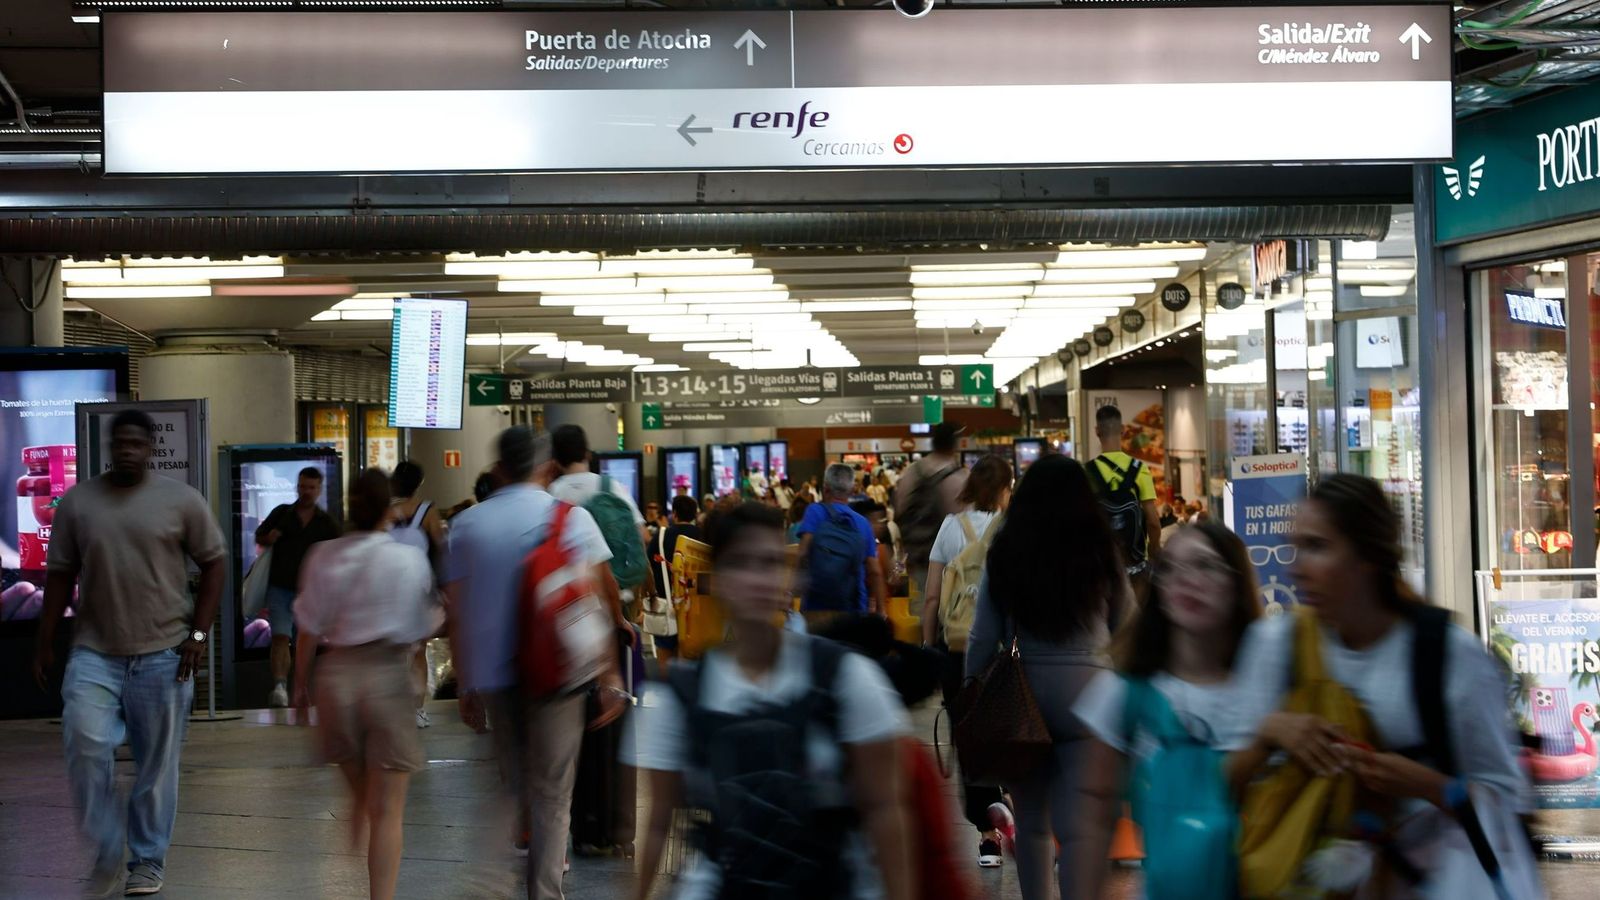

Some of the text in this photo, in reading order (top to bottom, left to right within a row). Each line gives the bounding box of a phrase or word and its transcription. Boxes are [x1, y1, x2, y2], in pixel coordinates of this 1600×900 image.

[525, 28, 711, 50] Puerta de Atocha
[1258, 22, 1372, 44] Salida/Exit
[1258, 45, 1380, 64] C/Méndez Álvaro
[525, 55, 670, 73] Salidas/Departures
[732, 101, 830, 139] renfe
[1165, 289, 1186, 301] DOTS
[750, 372, 820, 386] Llegadas Vías
[847, 370, 934, 382] Salidas Planta 1
[530, 377, 627, 391] Salidas Planta Baja
[1, 400, 30, 408] Tomates
[54, 409, 75, 417] Extrem
[152, 423, 175, 432] DO EL
[30, 449, 49, 459] FUNDA
[152, 448, 175, 457] RES Y
[158, 461, 190, 470] PESADA
[1252, 460, 1298, 473] Soloptical
[1245, 504, 1298, 519] TUS GAFAS
[1246, 520, 1298, 536] EN 1 HORA
[1541, 613, 1553, 624] EL
[1522, 625, 1587, 637] DEL VERANO
[1511, 641, 1600, 674] GRATIS
